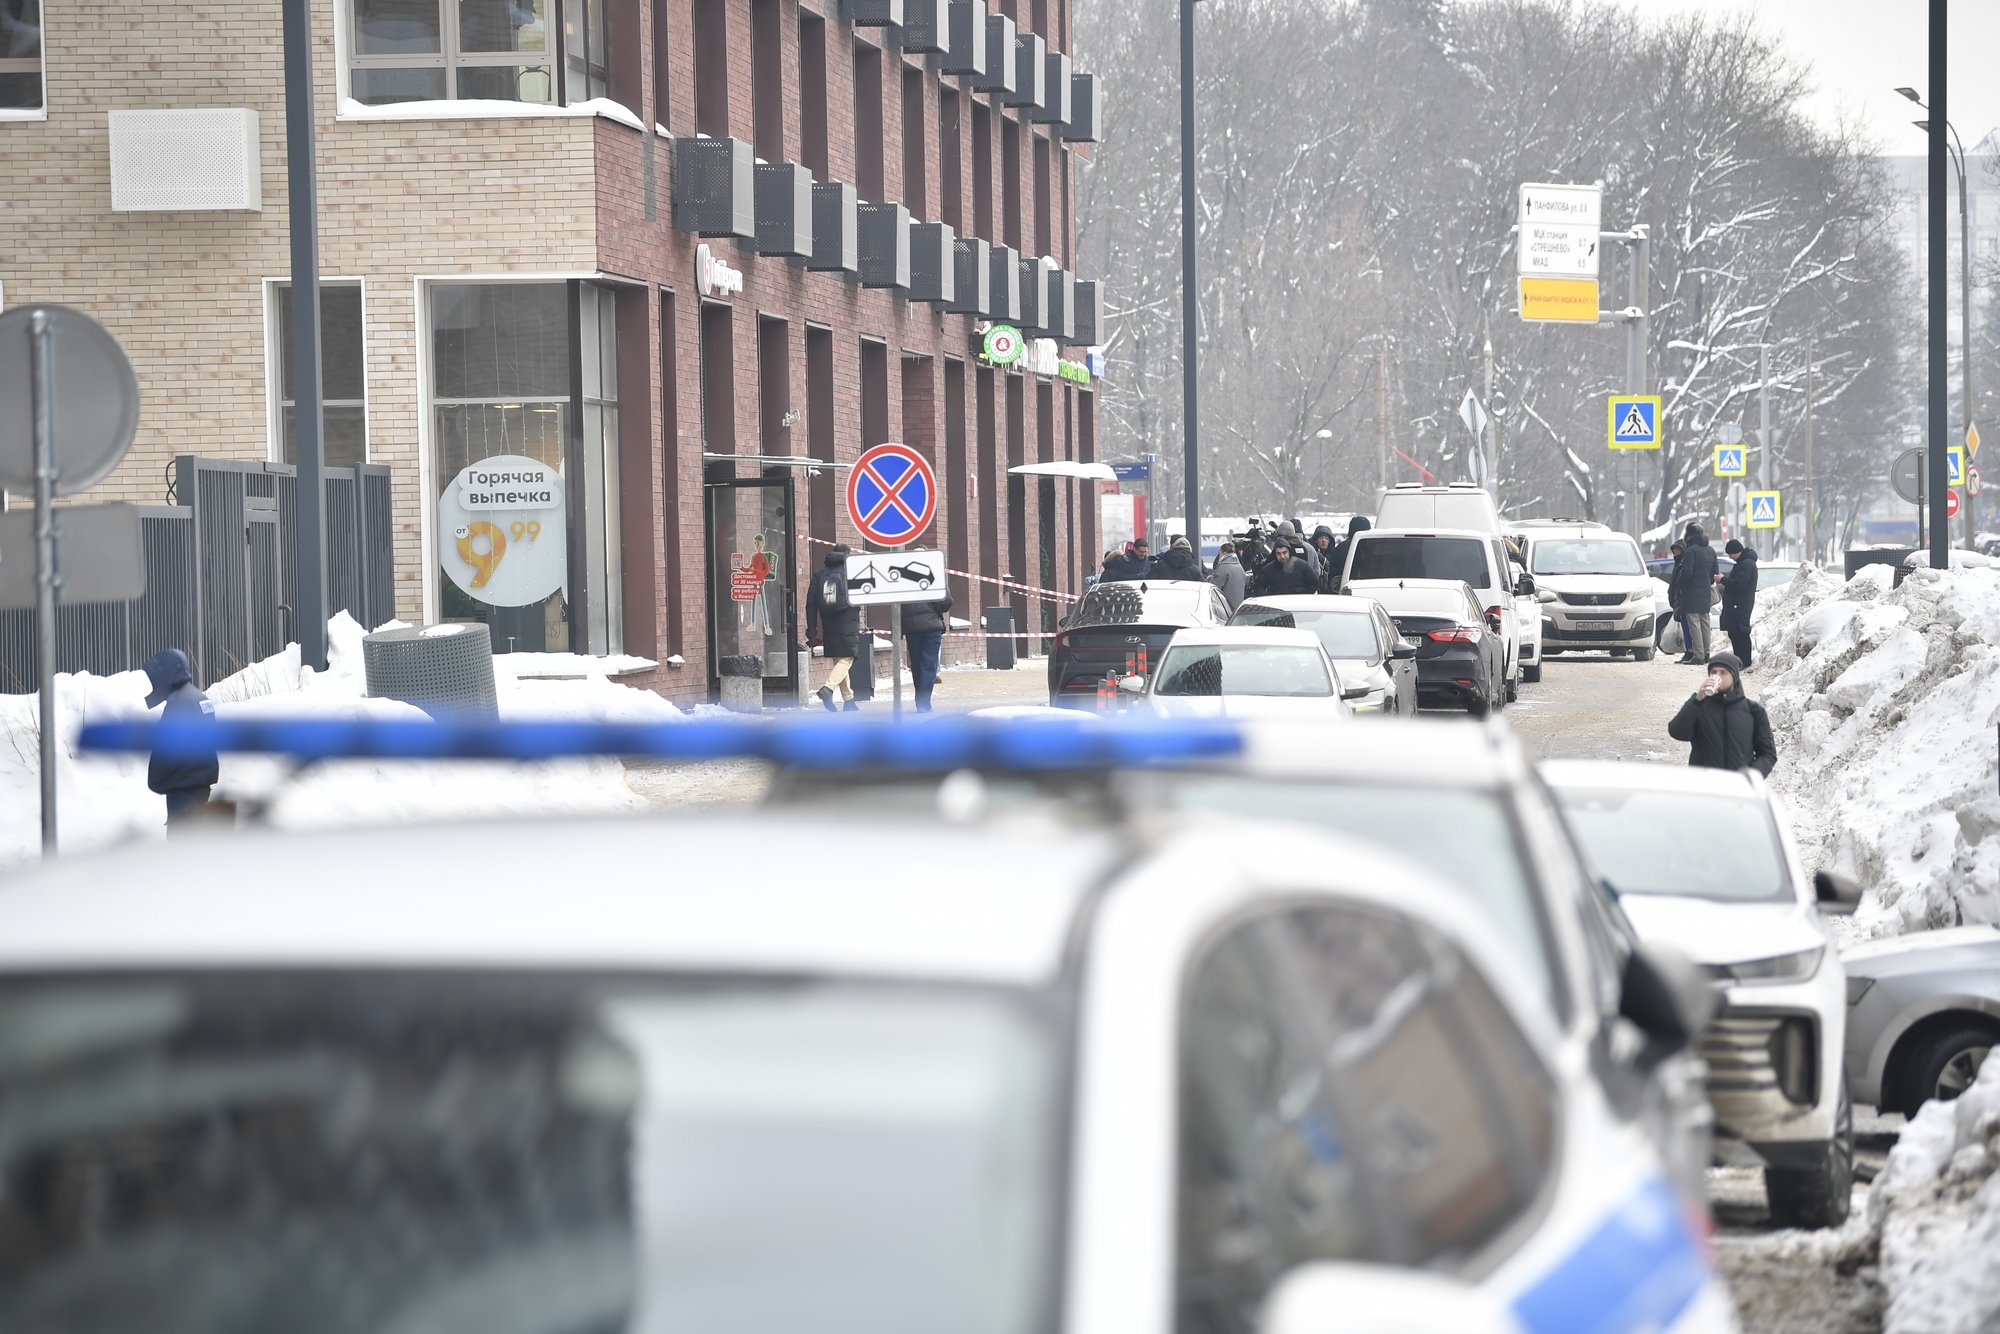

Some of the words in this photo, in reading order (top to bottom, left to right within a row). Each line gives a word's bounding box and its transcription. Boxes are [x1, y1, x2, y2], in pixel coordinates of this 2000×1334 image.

[1534, 201, 1569, 211] ПАНФИЛОВА
[1533, 228, 1545, 239] МЦК
[1546, 231, 1568, 240] станция
[1532, 257, 1549, 268] МКАД
[468, 470, 544, 488] Горячая
[469, 490, 551, 505] выпечка
[456, 527, 467, 535] от
[510, 519, 542, 543] 99
[456, 520, 507, 590] 9
